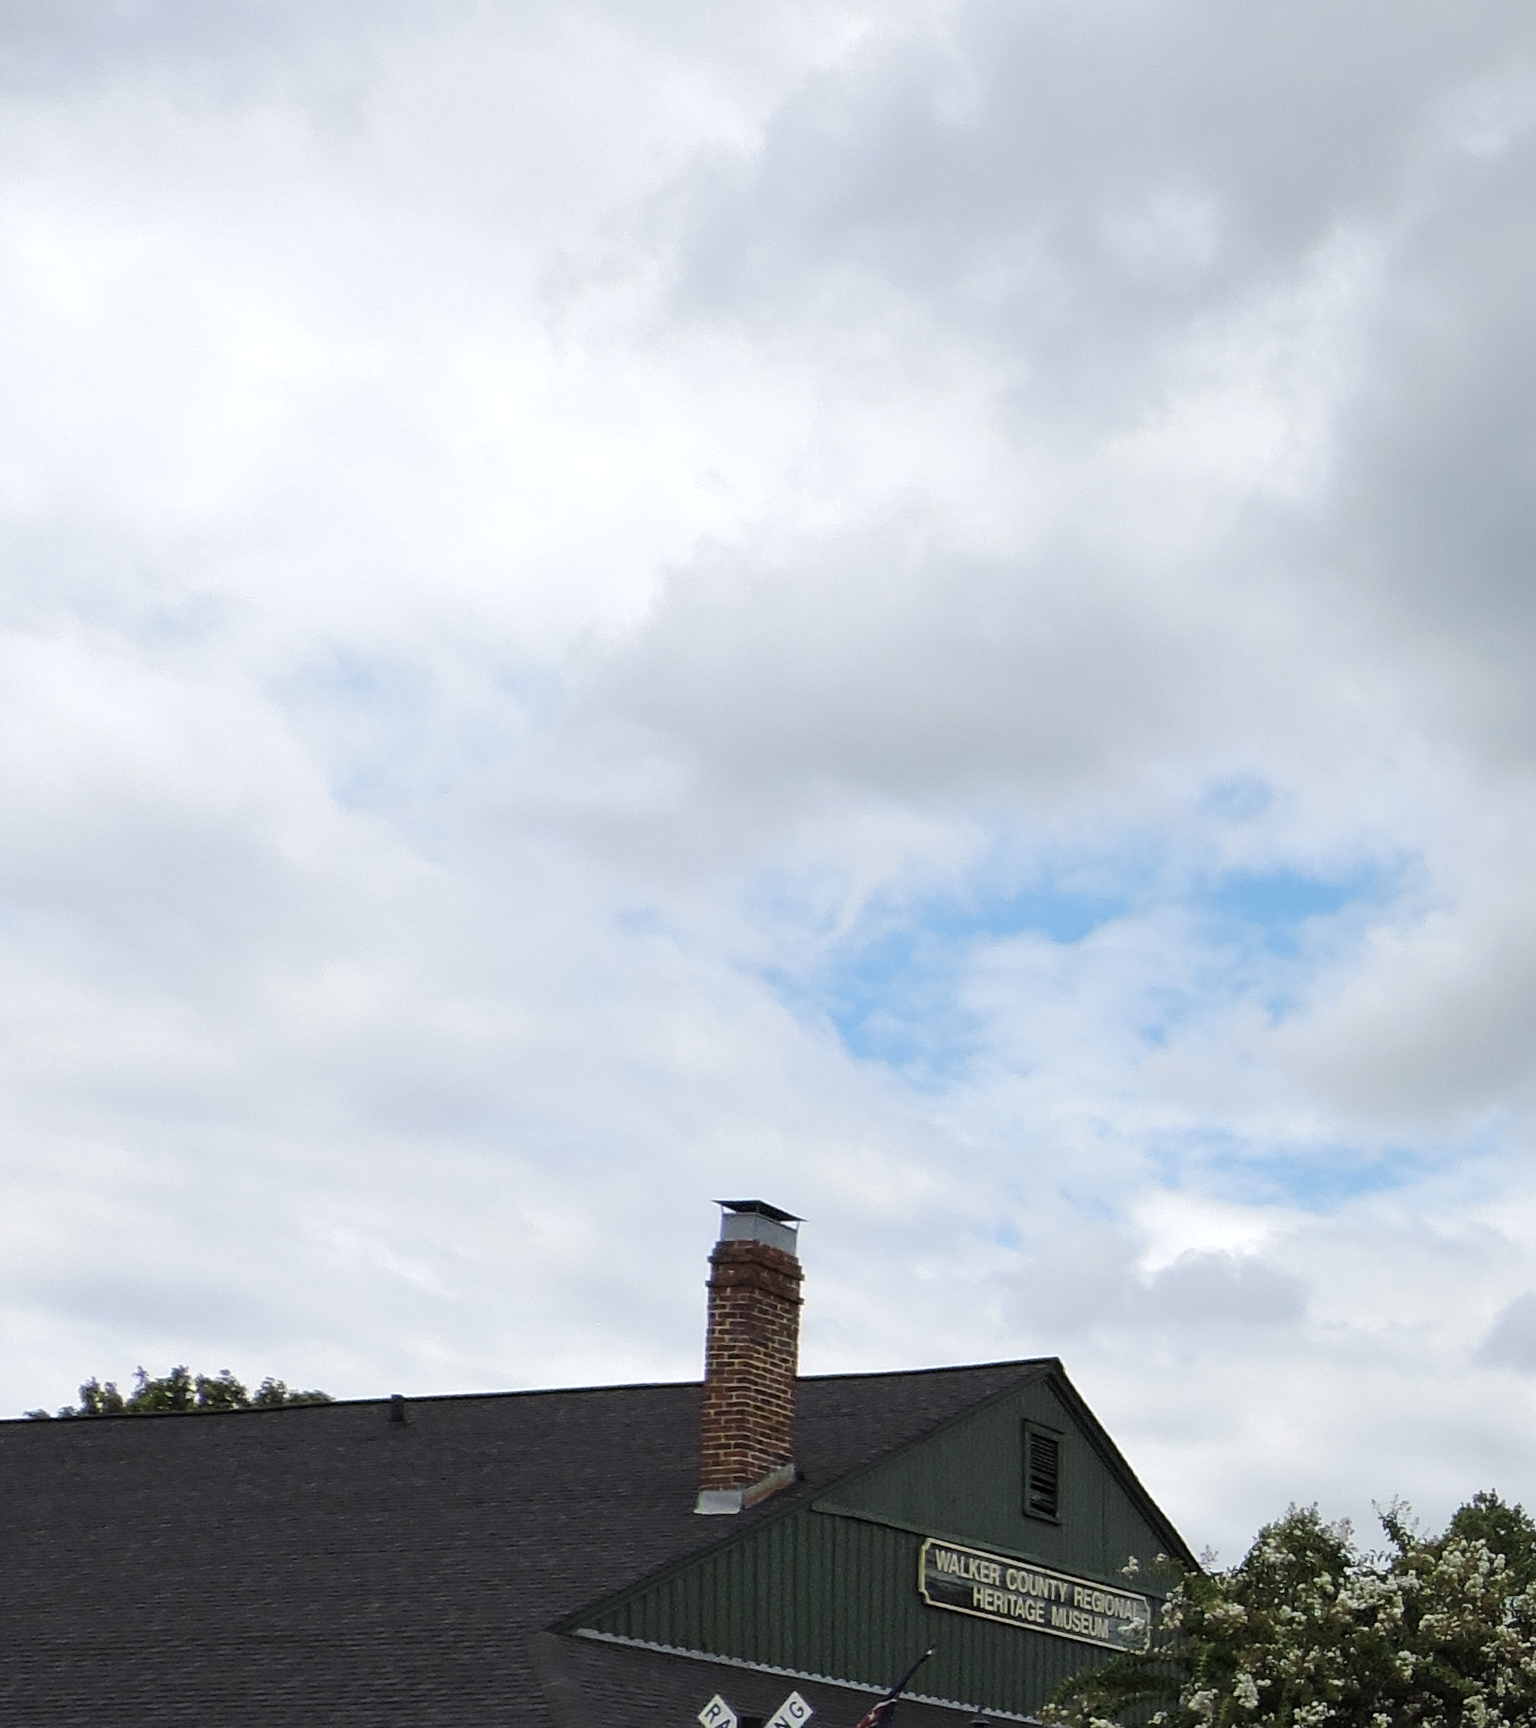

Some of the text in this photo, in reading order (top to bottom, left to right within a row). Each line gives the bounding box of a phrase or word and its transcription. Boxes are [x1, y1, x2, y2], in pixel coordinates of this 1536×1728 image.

[934, 1549, 1139, 1621] WALKER COUNTY REGIONAL
[972, 1585, 1110, 1639] HERITAGE MUSEUM
